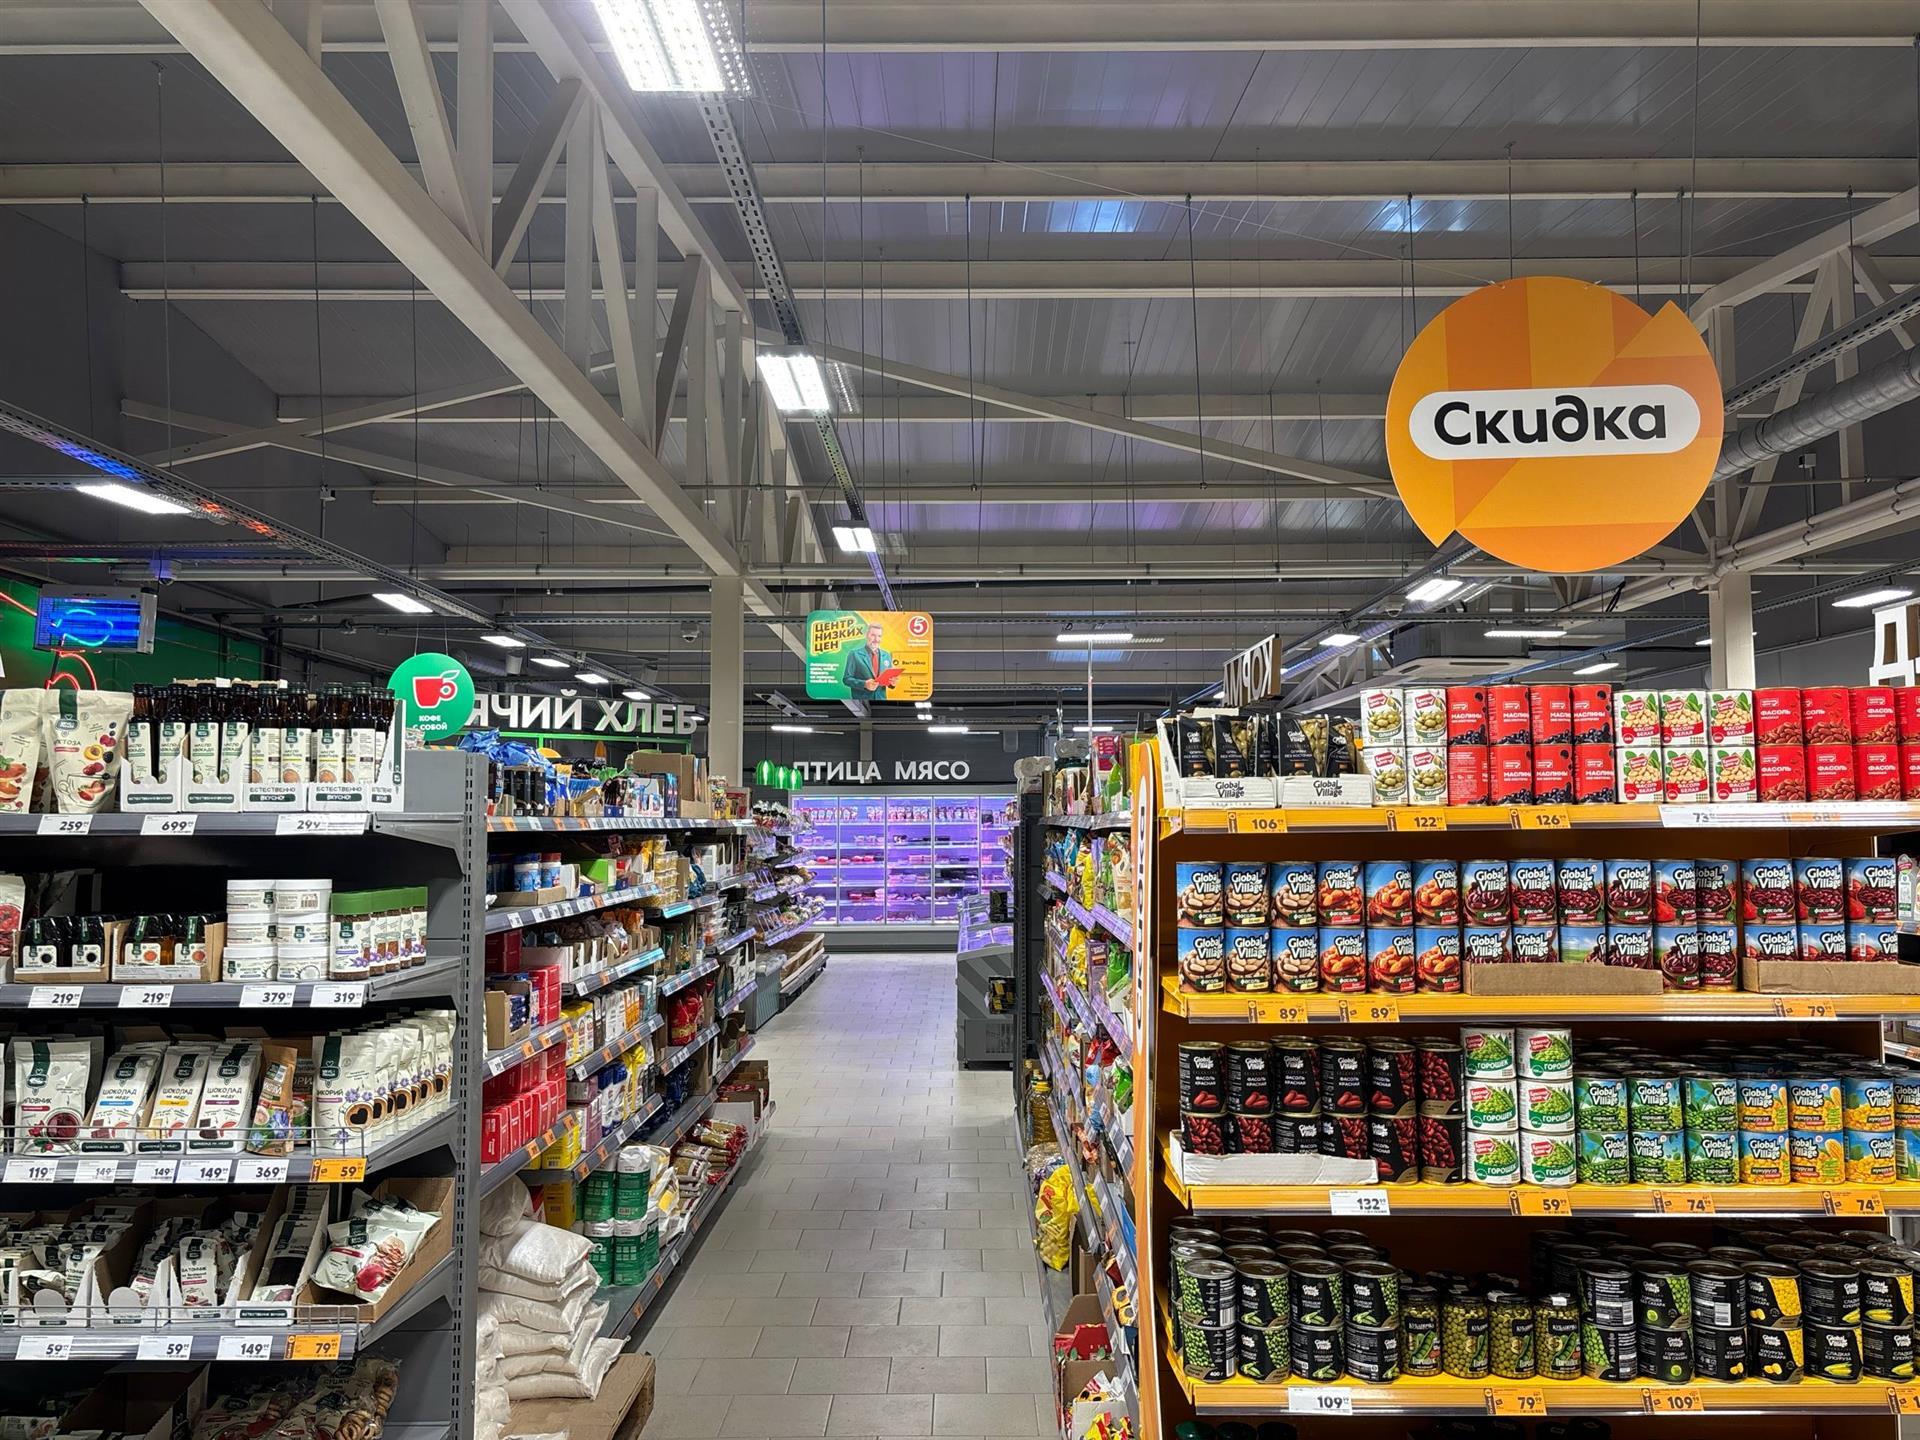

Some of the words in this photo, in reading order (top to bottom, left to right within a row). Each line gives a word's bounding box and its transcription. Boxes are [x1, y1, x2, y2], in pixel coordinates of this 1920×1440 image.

[1433, 394, 1667, 446] Скидка
[815, 619, 854, 632] ЦЕНТР
[913, 618, 925, 633] 5
[815, 627, 863, 642] НИЗКИХ
[815, 641, 838, 651] ЦЕН
[594, 700, 697, 735] ХЛЕБ
[420, 722, 447, 730] СОБОЙ
[793, 761, 882, 784] ПТИЦА
[895, 761, 970, 780] МЯСО
[1215, 781, 1244, 790] Global
[1313, 780, 1342, 789] Global
[1218, 789, 1244, 798] Village
[1316, 788, 1343, 797] Village
[1252, 819, 1277, 829] 106
[1414, 817, 1436, 827] 122
[1536, 815, 1560, 825] 126
[59, 821, 83, 831] 259
[161, 821, 187, 831] 699
[1325, 871, 1351, 880] Global
[1475, 870, 1502, 880] Global
[1517, 869, 1547, 879] Global
[1560, 869, 1589, 879] Global
[1618, 869, 1648, 879] Global
[1755, 868, 1786, 878] Global
[1807, 868, 1836, 878] Global
[1865, 866, 1895, 877] Global
[1193, 872, 1219, 883] Global
[1231, 873, 1259, 883] Global
[1288, 872, 1314, 883] Global
[1759, 877, 1790, 889] Village
[1199, 882, 1222, 894] Village
[1235, 882, 1263, 894] Village
[1292, 882, 1316, 894] Village
[1328, 878, 1355, 889] Village
[1480, 879, 1507, 891] Village
[1520, 878, 1550, 890] Village
[1562, 878, 1593, 890] Village
[1622, 878, 1650, 890] Village
[1811, 878, 1841, 889] Village
[1195, 938, 1221, 948] Global
[1235, 937, 1263, 948] Global
[1288, 938, 1315, 948] Global
[1335, 936, 1360, 947] Global
[1469, 936, 1498, 945] Global
[1515, 934, 1545, 944] Global
[1615, 934, 1645, 944] Global
[1759, 933, 1791, 943] Global
[1199, 947, 1222, 958] Village
[1238, 947, 1266, 958] Village
[1292, 947, 1317, 958] Village
[1337, 945, 1363, 955] Village
[1472, 945, 1503, 957] Village
[1518, 943, 1549, 955] Village
[1619, 944, 1648, 955] Village
[1763, 943, 1794, 955] Village
[52, 993, 73, 1004] 219
[142, 992, 164, 1003] 219
[262, 992, 285, 1003] 379
[334, 992, 355, 1003] 319
[1279, 1008, 1297, 1019] 89
[1370, 1008, 1389, 1018] 89
[1808, 1006, 1825, 1017] 79
[1477, 1059, 1508, 1070] ГОРОШЕК
[1589, 1087, 1616, 1096] Global
[1638, 1085, 1664, 1095] Global
[1742, 1088, 1769, 1097] Global
[1791, 1088, 1819, 1097] Global
[1866, 1088, 1891, 1097] Global
[1592, 1095, 1618, 1105] Village
[1641, 1095, 1668, 1105] Village
[1744, 1097, 1773, 1107] Village
[1794, 1097, 1824, 1107] Village
[1482, 1111, 1512, 1122] ГОРОШЕК
[1633, 1138, 1658, 1148] Global
[1702, 1140, 1729, 1148] Global
[1750, 1140, 1778, 1149] Global
[1636, 1146, 1663, 1158] Village
[1705, 1148, 1732, 1158] Village
[1753, 1149, 1780, 1159] Village
[29, 1167, 49, 1178] 119
[96, 1168, 111, 1176] 149
[154, 1168, 170, 1176] 149
[200, 1168, 221, 1178] 149
[256, 1167, 280, 1178] 369
[341, 1167, 356, 1176] 59
[1487, 1163, 1516, 1174] ГОРОШЕК
[1357, 1198, 1380, 1210] 132
[1543, 1199, 1560, 1210] 59
[1687, 1199, 1705, 1211] 74
[1856, 1199, 1875, 1211] 74
[46, 1344, 62, 1355] 59
[166, 1344, 183, 1355] 59
[240, 1343, 262, 1355] 149
[316, 1343, 331, 1354] 79
[1318, 1397, 1342, 1408] 109
[1518, 1397, 1535, 1409] 79
[1668, 1397, 1693, 1408] 109
